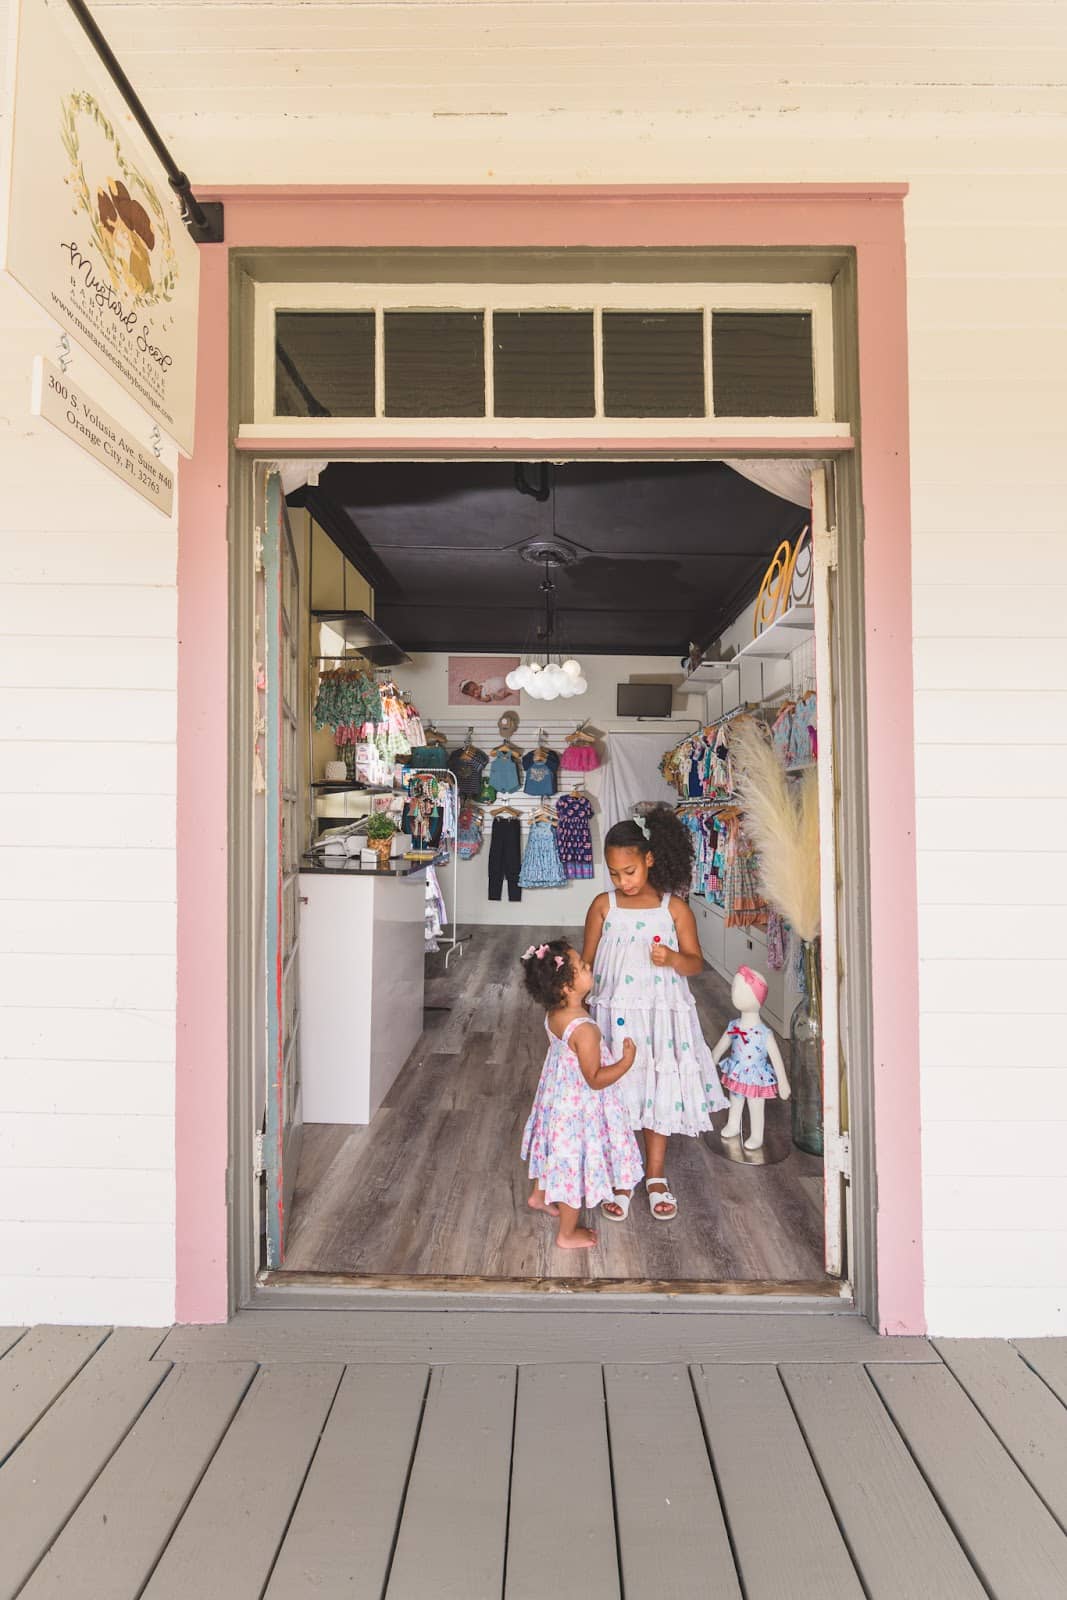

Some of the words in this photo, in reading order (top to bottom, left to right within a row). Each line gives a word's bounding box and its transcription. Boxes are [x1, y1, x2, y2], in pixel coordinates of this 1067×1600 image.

[61, 242, 137, 333] Mustard
[137, 325, 173, 373] Seed
[48, 376, 68, 400] 300
[70, 394, 79, 411] S.
[83, 405, 116, 441] Volusia
[66, 410, 101, 447] Orange
[138, 470, 160, 494] 32763
